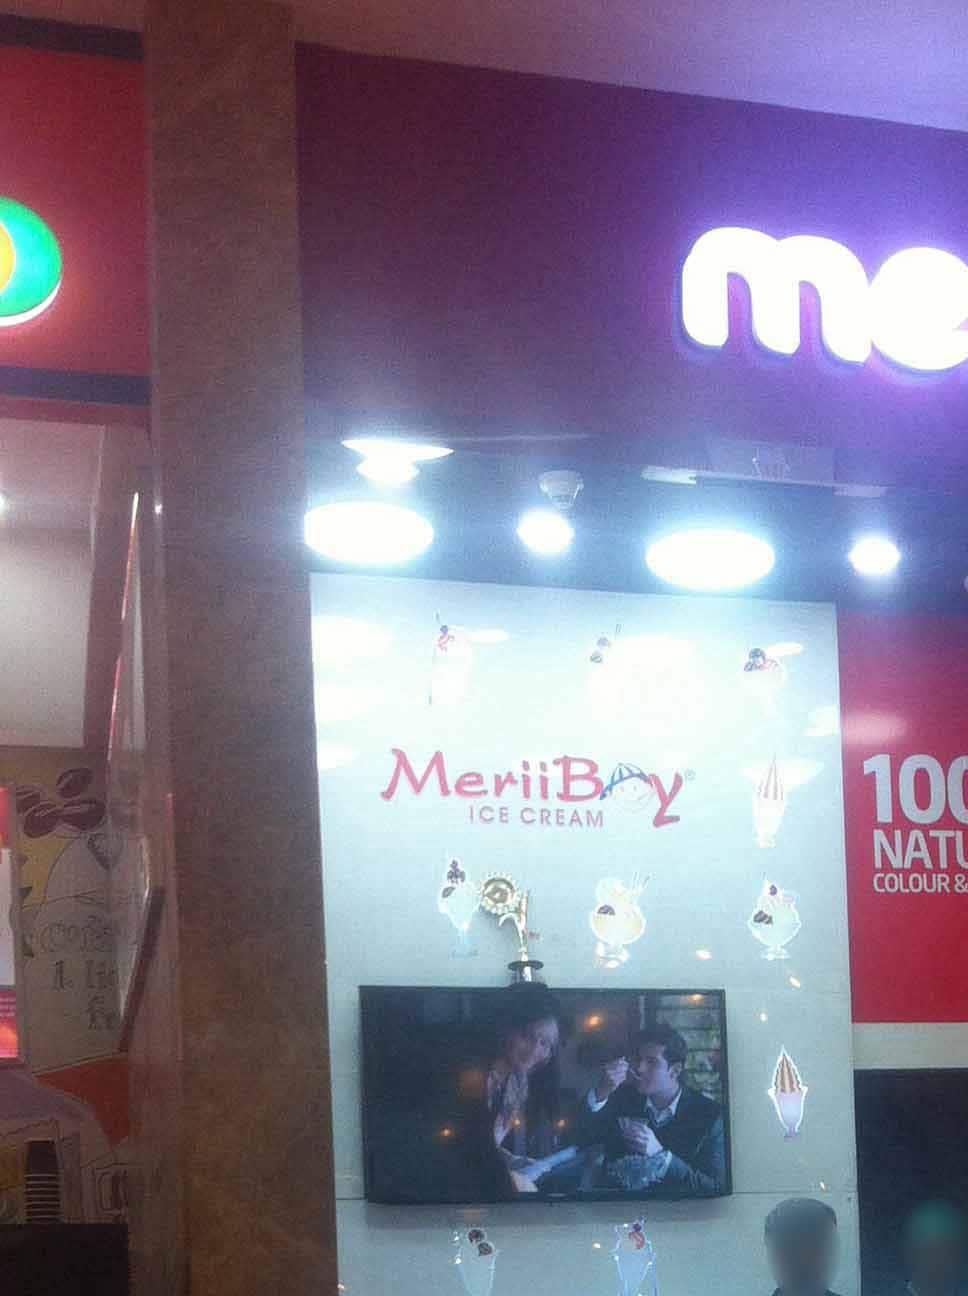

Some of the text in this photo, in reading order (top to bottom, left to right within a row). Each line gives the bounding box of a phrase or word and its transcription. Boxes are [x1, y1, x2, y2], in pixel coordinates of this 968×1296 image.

[469, 805, 604, 828] ICE CREAM
[872, 873, 951, 894] COLOUR
[954, 873, 968, 893] &
